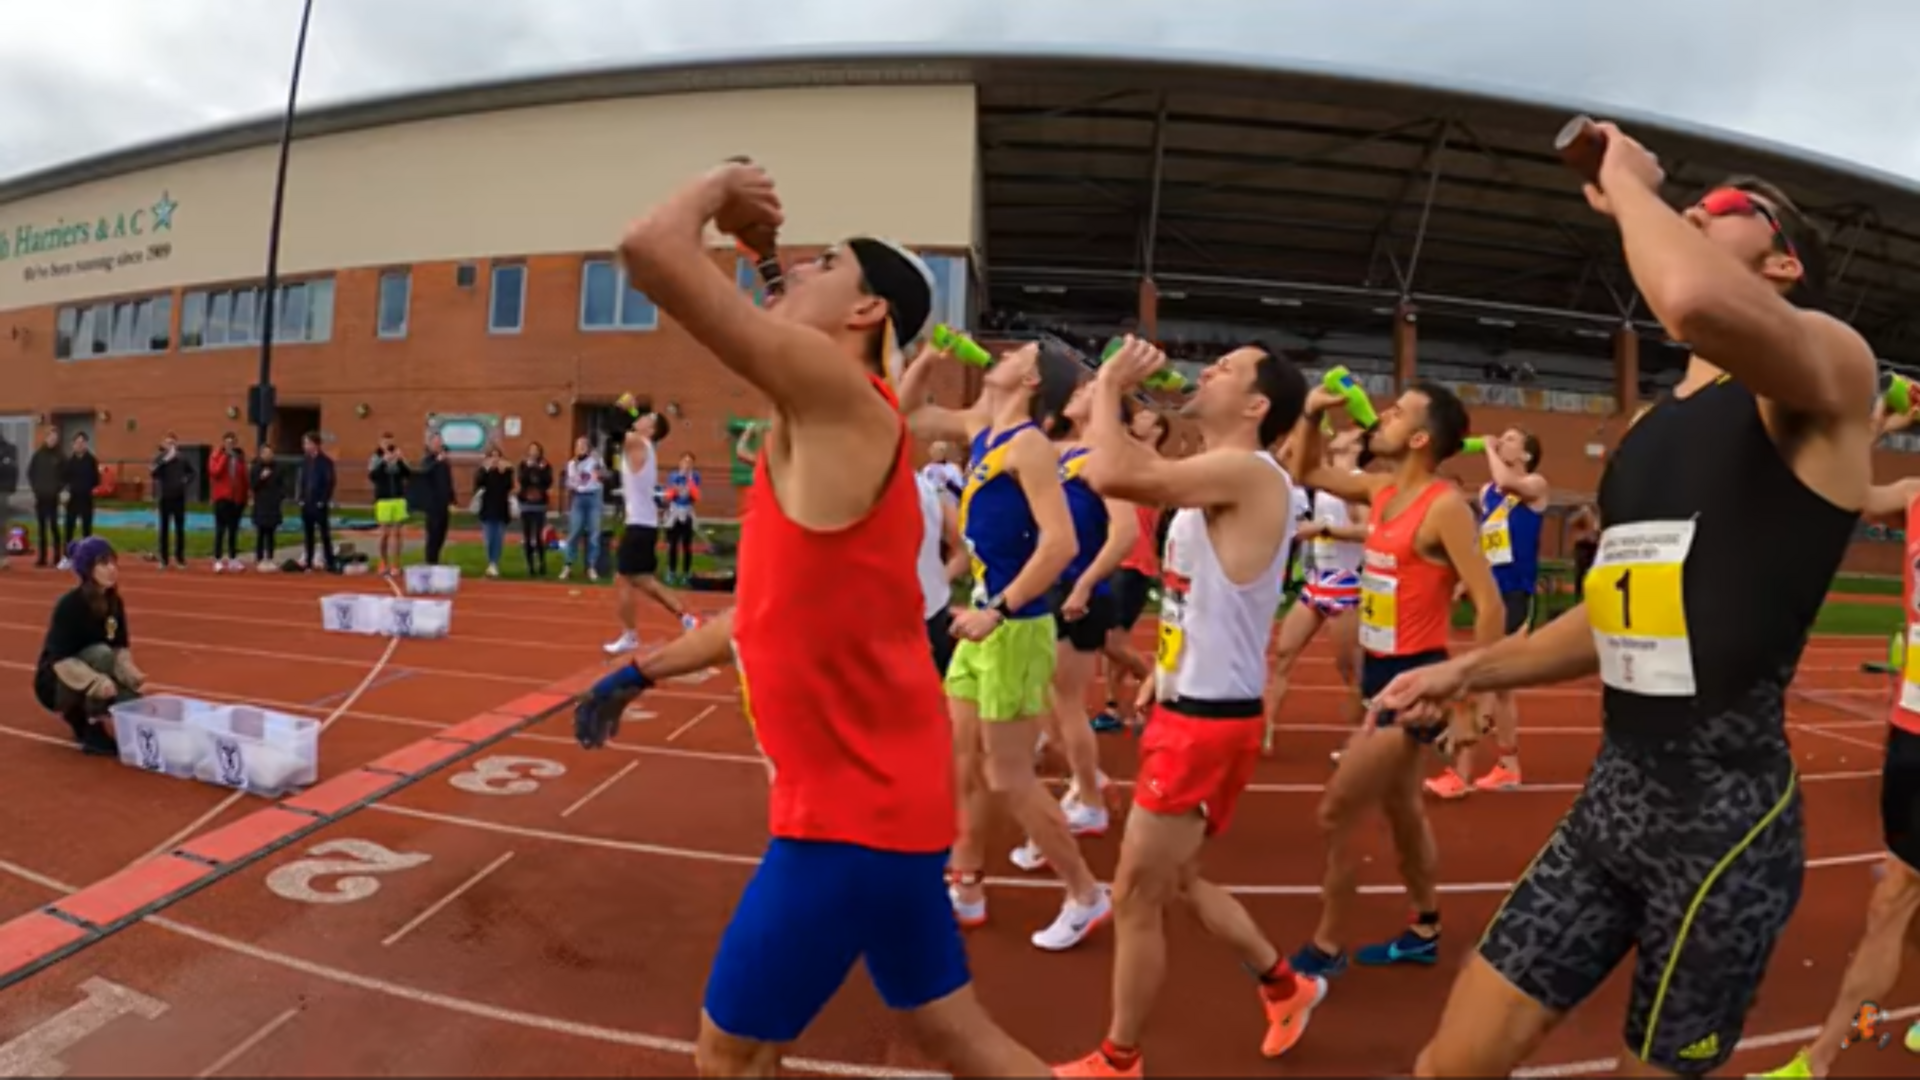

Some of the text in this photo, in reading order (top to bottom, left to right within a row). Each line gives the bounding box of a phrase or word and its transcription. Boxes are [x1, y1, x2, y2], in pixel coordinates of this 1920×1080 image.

[13, 216, 90, 257] Harriers
[95, 217, 110, 242] &
[1613, 568, 1631, 630] 1
[448, 754, 567, 795] 3
[265, 838, 433, 903] 2
